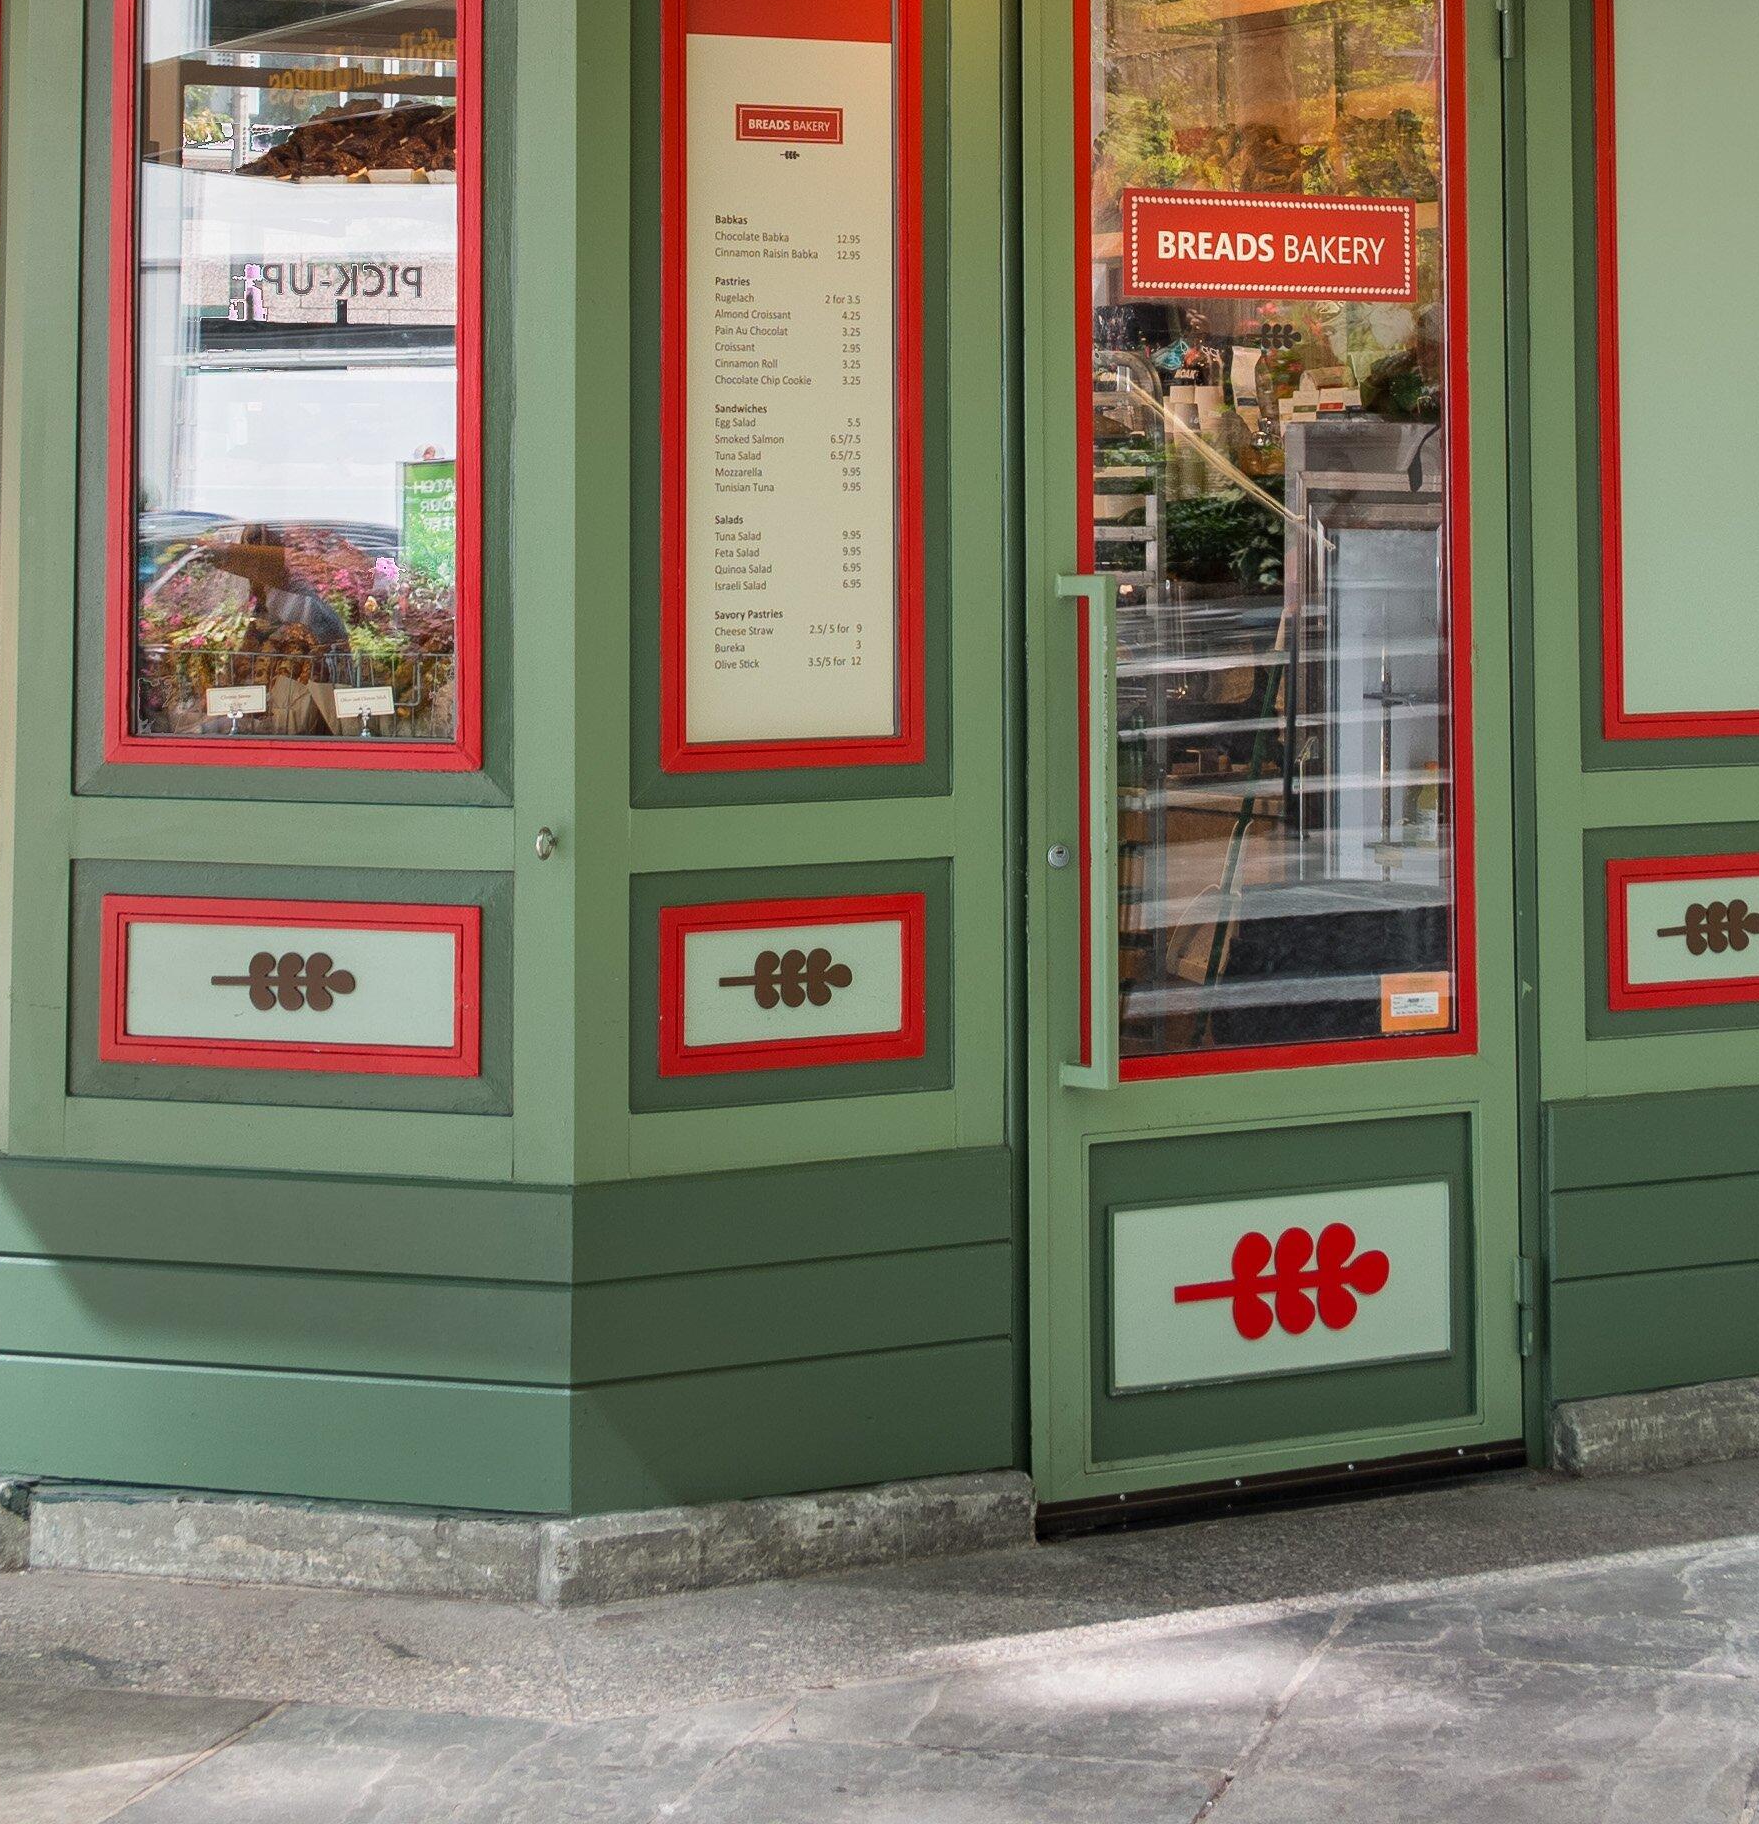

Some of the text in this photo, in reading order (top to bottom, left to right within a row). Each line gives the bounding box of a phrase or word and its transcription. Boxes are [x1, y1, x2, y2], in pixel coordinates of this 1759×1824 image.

[748, 118, 831, 133] BREADS BAKERY
[715, 215, 748, 225] Babkas
[715, 232, 860, 244] Chocolate Babka 12.95
[1157, 230, 1386, 265] BREADS BAKERY
[715, 248, 860, 260] Cinnamon Raisin Babka 12.95
[715, 277, 750, 286] Pastries
[715, 293, 860, 304] Rugelach 2 for 3.5
[715, 310, 861, 320] Almond Croissant 4.25
[715, 327, 861, 336] Pain Au Chocolat 3.25
[715, 343, 861, 353] Croissant 2.95
[715, 359, 861, 369] Cinnamon Roll 3.25
[715, 375, 861, 386] Chocolate Chip Cookie 3.25
[715, 404, 767, 413] Sandwiches
[715, 418, 861, 429] Egg Salad 5.5
[715, 435, 861, 445] Smoked Salmon 6.5/7.5
[715, 451, 861, 461] Tuna Salad 6.5/7.5
[715, 467, 861, 477] Mozzarella 9.95
[715, 483, 861, 492] Tunisian Tuna 9.95
[715, 515, 743, 524] Salads
[715, 530, 861, 541] Tuna Salad 9.95
[715, 547, 861, 557] Feta Salad 9.95
[715, 563, 861, 574] Quinoa Salad 6.95
[715, 579, 861, 591] Israeli Salad 6.95
[715, 609, 783, 621] Savory Pastries
[715, 627, 746, 636] Cheese
[749, 627, 774, 635] Straw
[837, 624, 849, 633] for
[857, 624, 862, 633] 9
[715, 640, 861, 653] Bureka 3
[715, 657, 861, 669] Olive Stick 3.5/5 for 12
